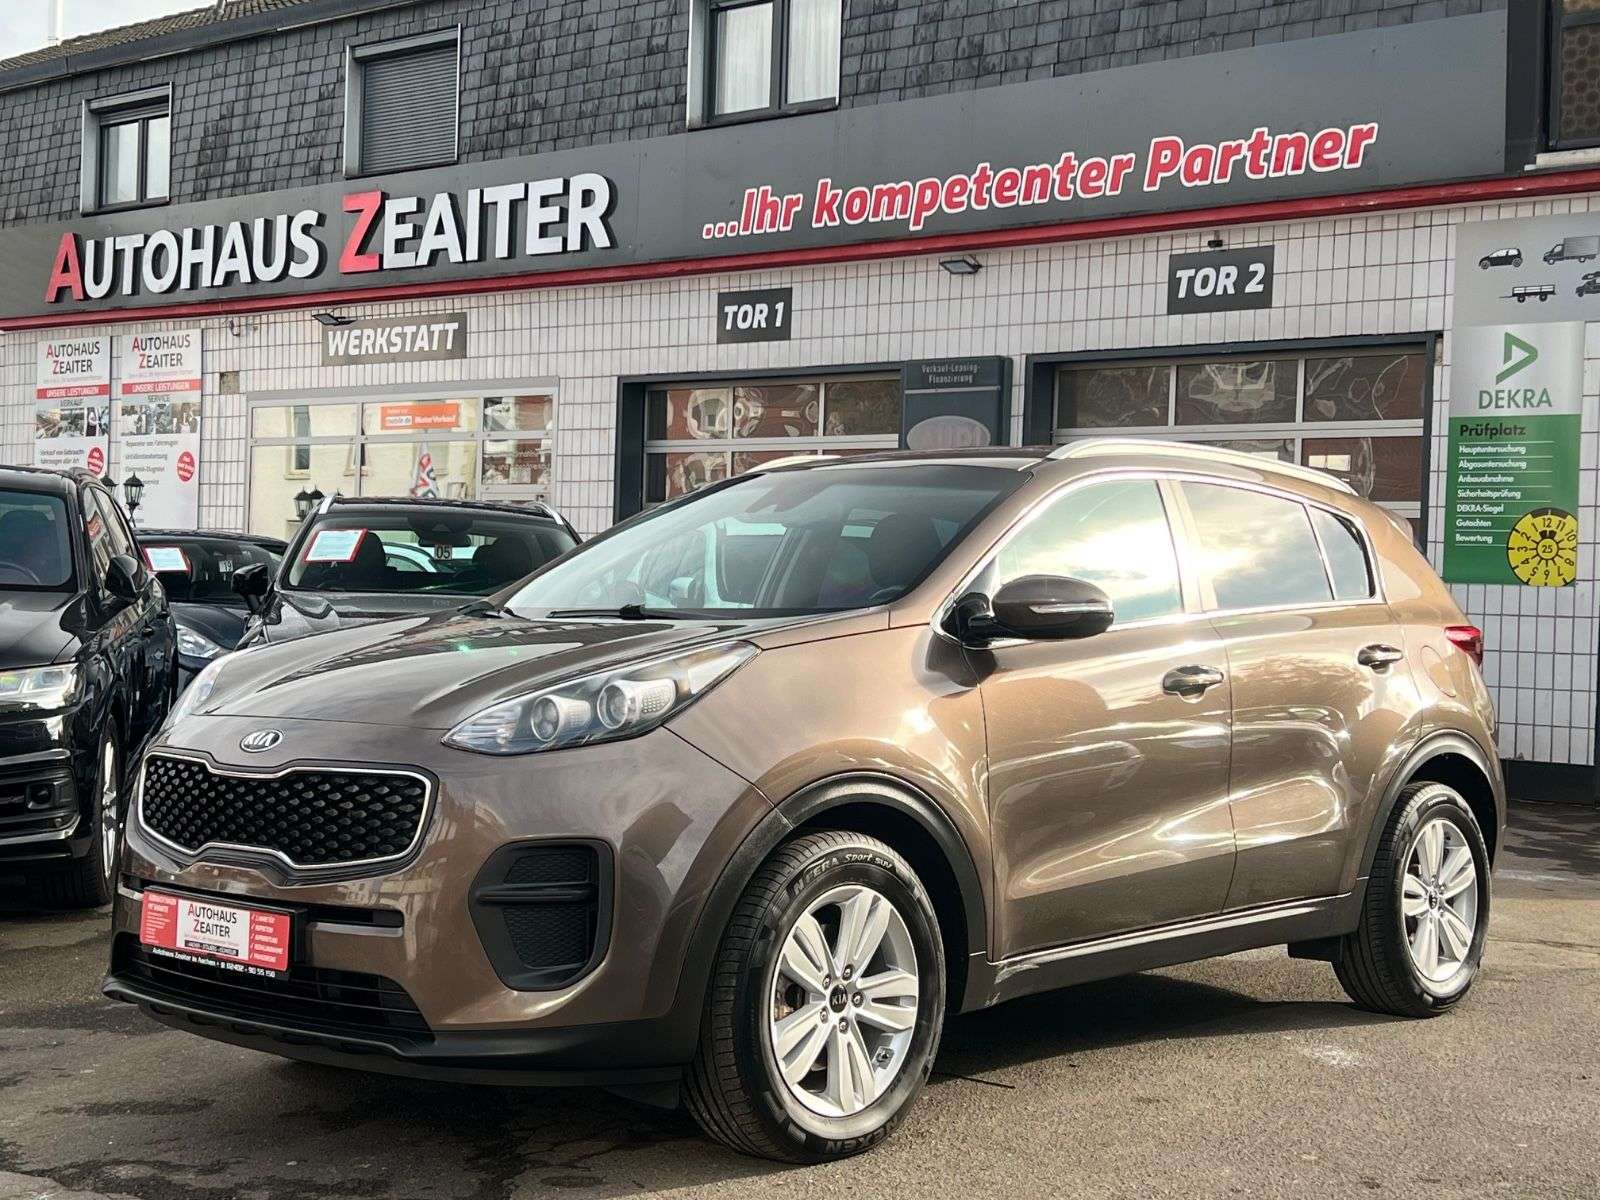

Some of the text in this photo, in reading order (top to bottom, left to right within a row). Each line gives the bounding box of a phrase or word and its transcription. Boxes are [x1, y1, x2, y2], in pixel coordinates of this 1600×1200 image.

[702, 122, 1378, 239] ...Ihr kompetenter Partner
[44, 173, 614, 303] AUTOHAUS ZEAITER
[1175, 263, 1265, 299] TOR 2
[723, 302, 784, 331] TOR 1
[132, 334, 191, 352] AUTOHAUS
[327, 322, 459, 357] WERKSTATT
[46, 341, 100, 359] AUTOHAUS
[52, 359, 93, 375] ZEAITER
[139, 353, 183, 369] ZEAITER
[928, 374, 974, 384] Finanzierung
[46, 388, 67, 398] UNSERE
[132, 381, 190, 393] UNSERE LEISTUNGEN
[1478, 388, 1552, 409] DEKRA
[1460, 423, 1526, 439] Prüfplatz
[1459, 444, 1526, 455] Hauptuntersuchung
[1458, 459, 1527, 470] Abgasuntersuchung
[1458, 474, 1515, 483] Anbauabnahme
[1457, 489, 1521, 499] Sicherheitsprüfung
[1456, 504, 1504, 514] DEKRA-Siegel
[1456, 519, 1492, 527] Gutachten
[1543, 518, 1552, 528] 12
[1556, 520, 1566, 532] 11
[1455, 534, 1493, 543] Bewertung
[1521, 532, 1531, 541] 2
[1565, 529, 1577, 541] 10
[435, 546, 451, 559] 05
[1541, 545, 1553, 553] 25
[1564, 558, 1575, 566] 8
[1530, 567, 1539, 576] 5
[845, 853, 873, 862] Sport
[874, 857, 893, 869] SUV
[187, 903, 237, 924] AUTOHAUS
[193, 919, 231, 938] ZEAITER
[152, 947, 174, 958] Autohaus
[175, 951, 191, 960] Zeaiter
[831, 994, 848, 1005] KIA
